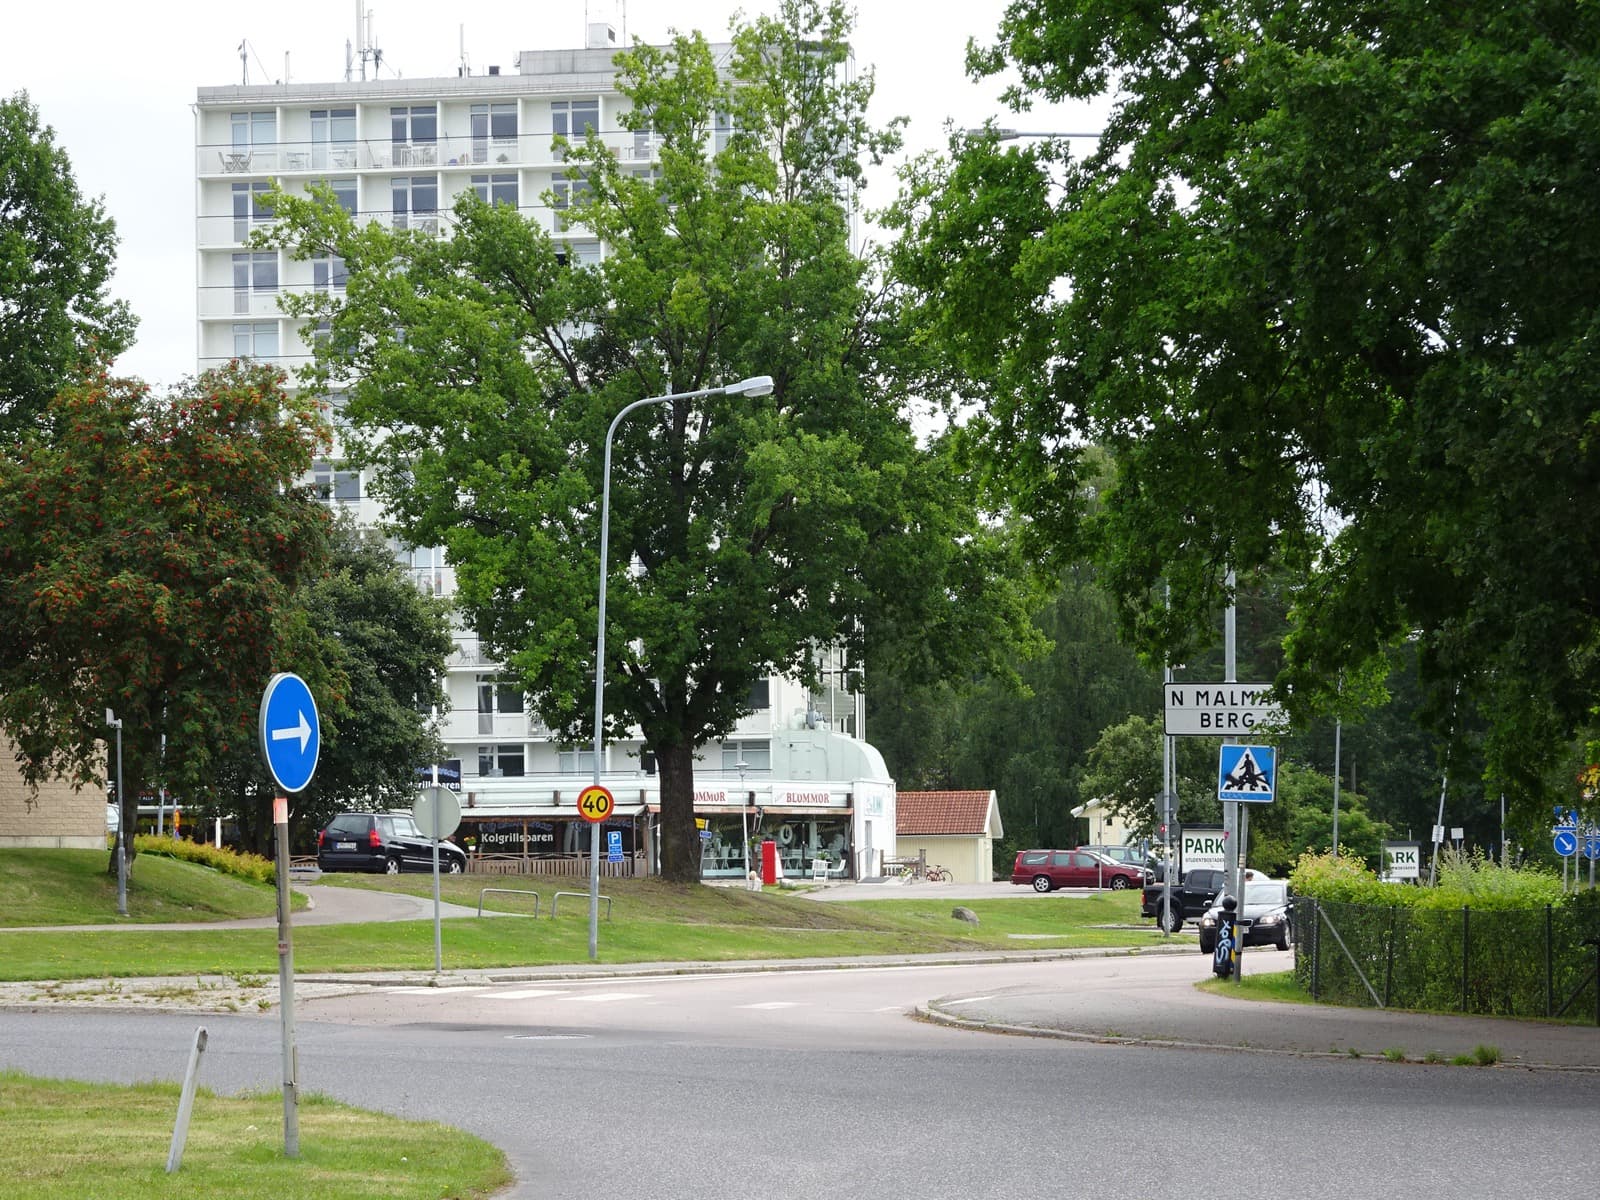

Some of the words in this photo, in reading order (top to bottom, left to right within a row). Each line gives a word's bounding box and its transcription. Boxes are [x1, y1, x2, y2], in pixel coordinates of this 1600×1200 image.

[1171, 690, 1184, 706] N
[1200, 712, 1255, 729] BERG
[582, 794, 609, 813] 40
[693, 791, 726, 802] OMMOR
[786, 792, 830, 803] BLOMMOR
[610, 833, 620, 844] P
[1185, 838, 1225, 854] PARK
